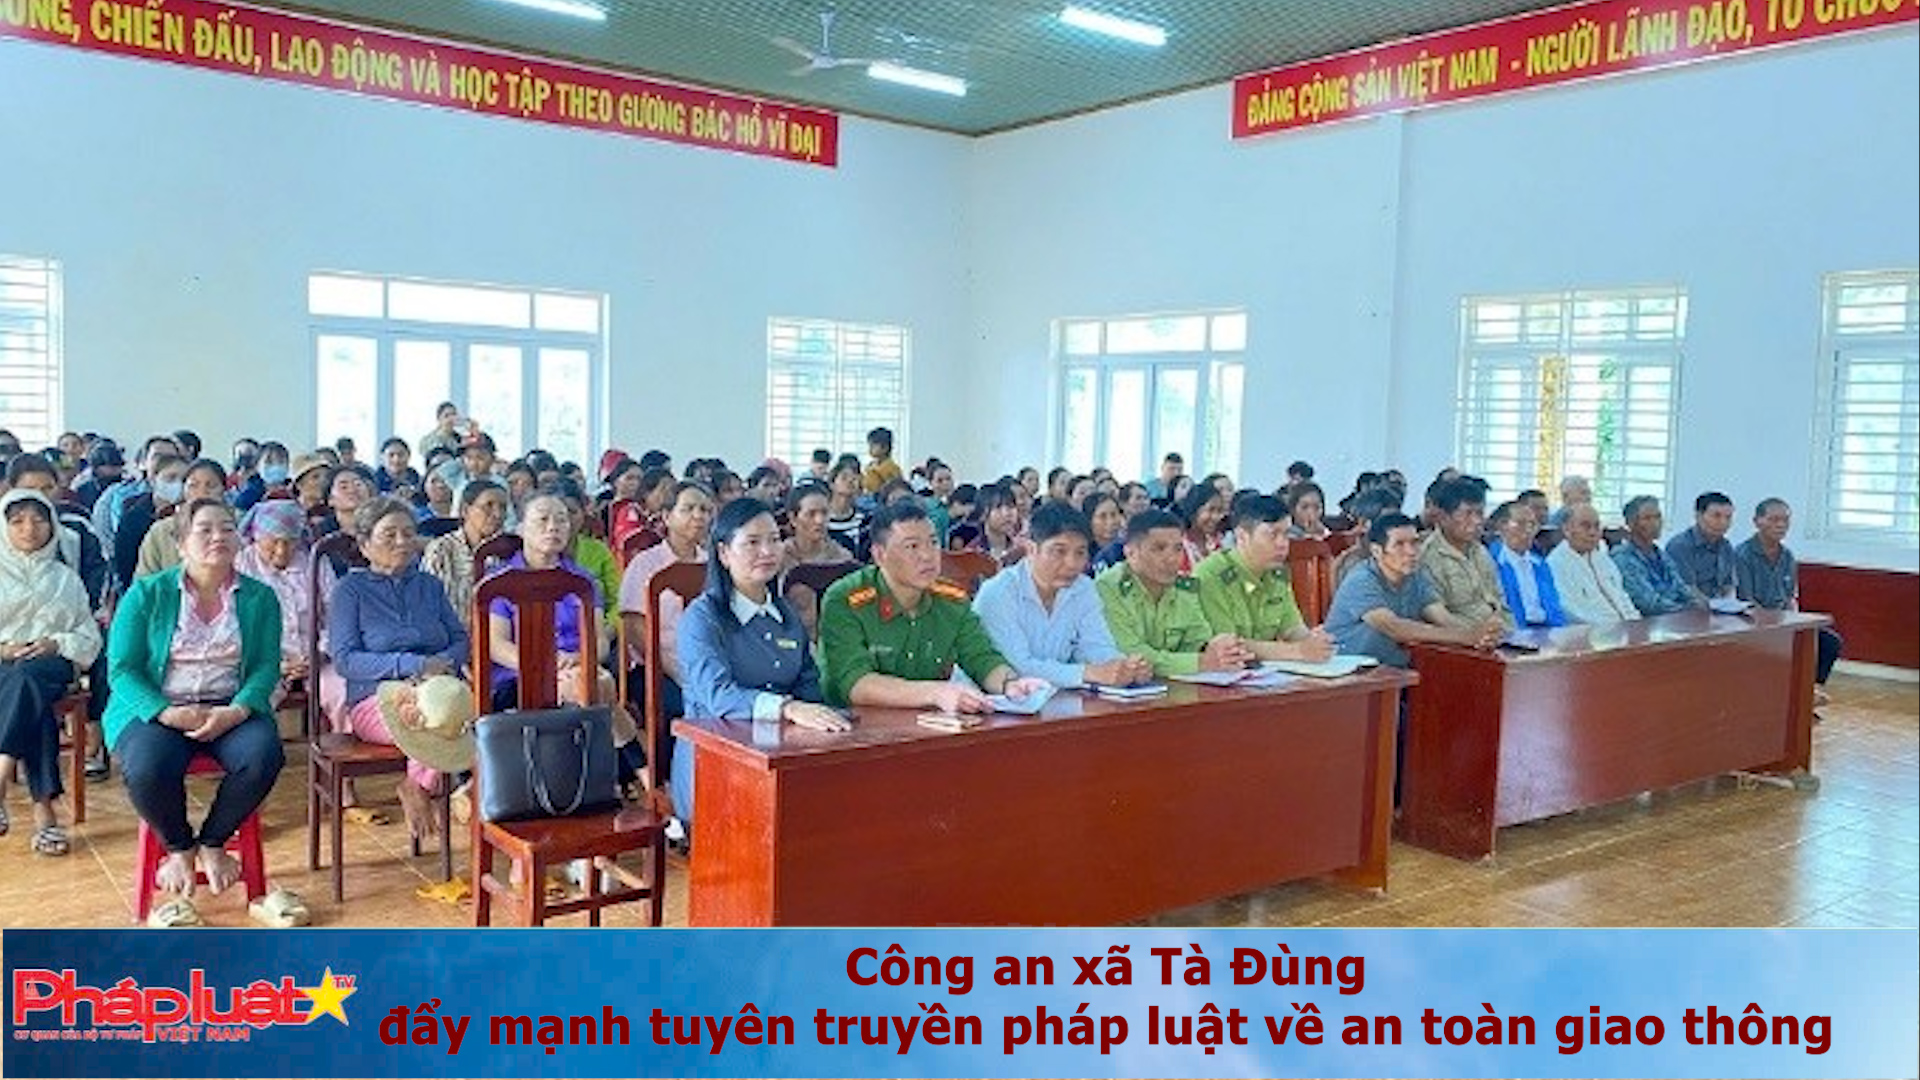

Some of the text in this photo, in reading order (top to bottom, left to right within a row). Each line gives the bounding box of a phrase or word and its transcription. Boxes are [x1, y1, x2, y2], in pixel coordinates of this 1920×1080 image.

[89, 0, 184, 54] CHIẾN
[192, 10, 262, 74] ĐẤU,
[271, 32, 324, 77] LAO
[332, 38, 403, 91] ĐỘNG
[410, 50, 441, 98] VÀ
[449, 63, 499, 109] HỌC
[504, 67, 550, 117] TẬP
[556, 83, 612, 123] THEO
[692, 101, 731, 142] BÁC
[735, 103, 762, 147] HỒ
[767, 112, 788, 150] VĨ
[789, 122, 822, 161] ĐẠI
[1247, 78, 1297, 127] ĐẢNG
[1299, 72, 1349, 122] CỘNG
[1353, 57, 1392, 108] SẢN
[1397, 50, 1445, 101] VIỆT
[1449, 47, 1500, 91] NAM
[1526, 18, 1600, 76] NGƯỜI
[1607, 7, 1678, 62] LÃNH
[1687, 0, 1754, 52] ĐẠO,
